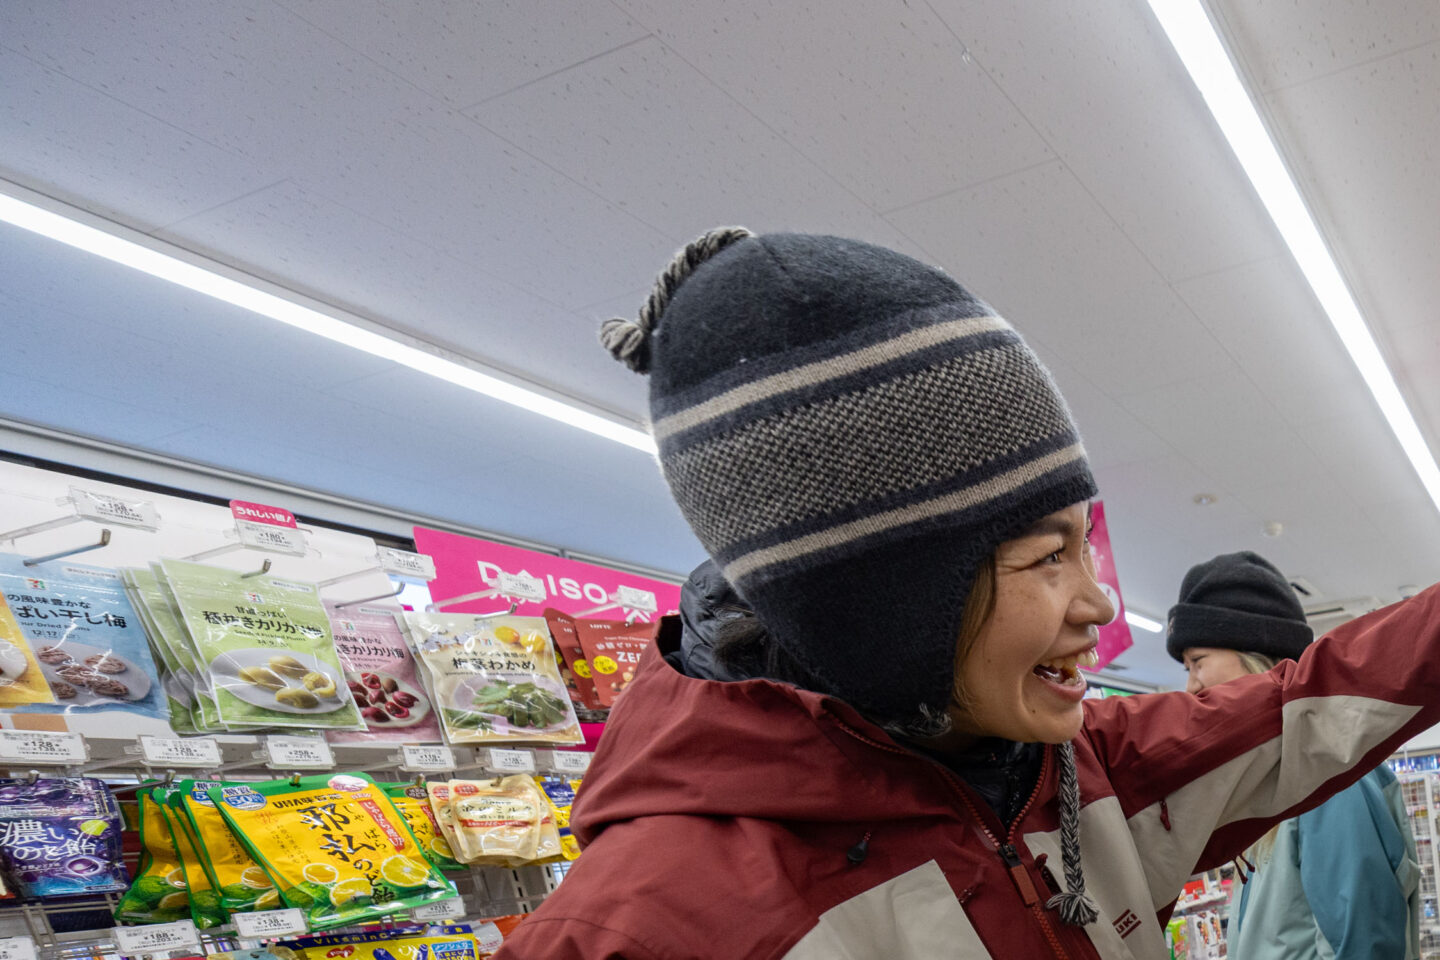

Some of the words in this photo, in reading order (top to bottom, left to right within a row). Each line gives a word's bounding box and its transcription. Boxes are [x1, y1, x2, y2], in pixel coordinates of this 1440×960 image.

[236, 505, 293, 523] うれしい値!
[477, 560, 608, 605] DISO
[7, 594, 92, 609] の風味豊かな
